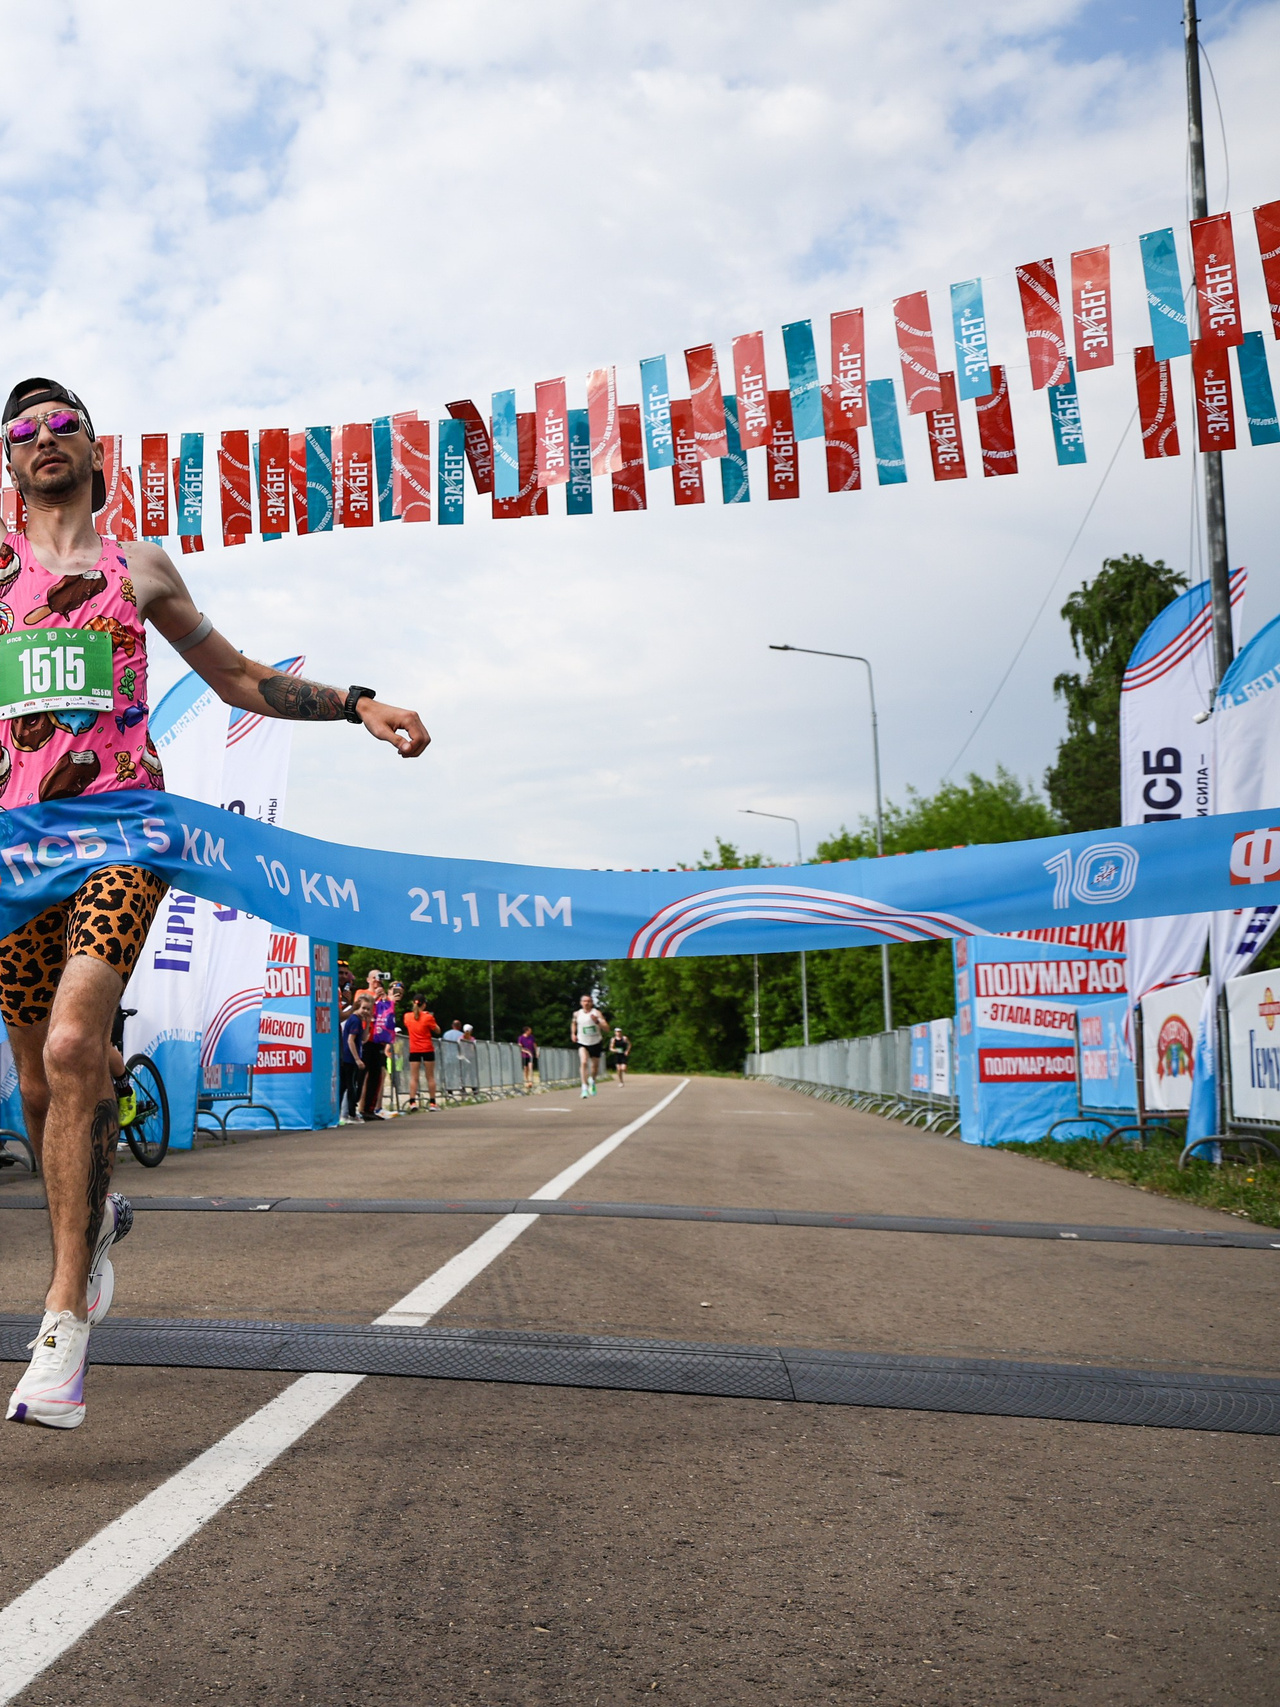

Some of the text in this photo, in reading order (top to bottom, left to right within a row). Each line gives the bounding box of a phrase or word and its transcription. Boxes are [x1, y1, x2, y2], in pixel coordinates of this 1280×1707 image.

[18, 646, 85, 695] 1515
[1196, 767, 1209, 806] СИЛА
[1, 827, 107, 886] ПСБ
[142, 818, 170, 853] 5
[181, 823, 232, 871] КМ
[255, 854, 360, 912] 10 КМ
[1042, 841, 1140, 910] 10
[407, 886, 573, 933] 21,1 КМ
[978, 960, 1127, 996] ПОЛУМАРАФ
[990, 1003, 1030, 1025] ЭТАПА
[257, 1049, 306, 1068] ЗАБЕГ.РФ
[984, 1056, 1075, 1076] ПОЛУМАРАФО
